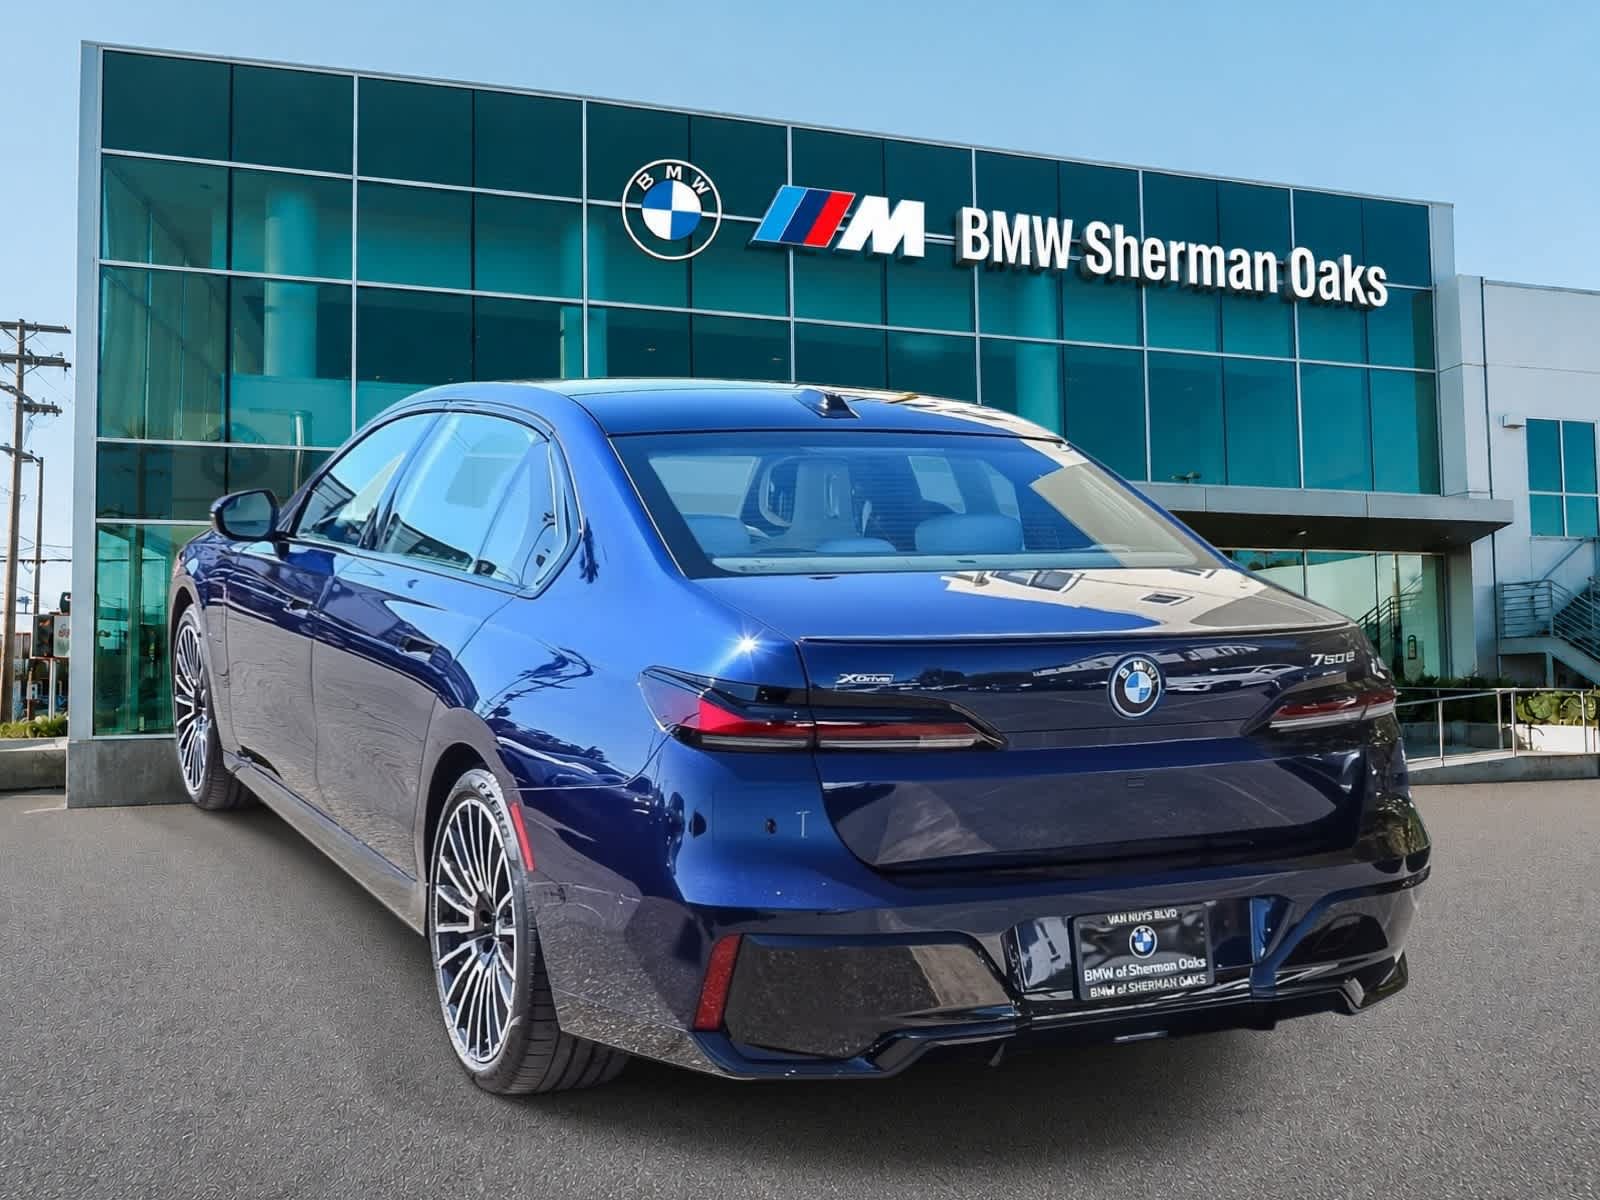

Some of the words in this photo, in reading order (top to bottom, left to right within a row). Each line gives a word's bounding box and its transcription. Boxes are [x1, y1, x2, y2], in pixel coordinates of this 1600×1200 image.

[636, 165, 711, 195] BMW
[835, 195, 925, 258] M
[961, 206, 1074, 270] BMW
[1085, 220, 1278, 293] Sherman
[1289, 247, 1389, 308] Oaks
[1311, 650, 1356, 666] 750e
[485, 790, 511, 838] NUYS
[1107, 913, 1128, 925] VAN
[1154, 908, 1177, 919] BLVD
[1084, 966, 1114, 982] BMW
[1116, 964, 1127, 977] of
[1129, 961, 1176, 976] Sherman
[1178, 957, 1207, 970] Oaks
[1090, 985, 1115, 998] BMW
[1117, 983, 1126, 995] of
[1128, 978, 1177, 992] SHERMAN
[1178, 974, 1207, 987] OAKS
